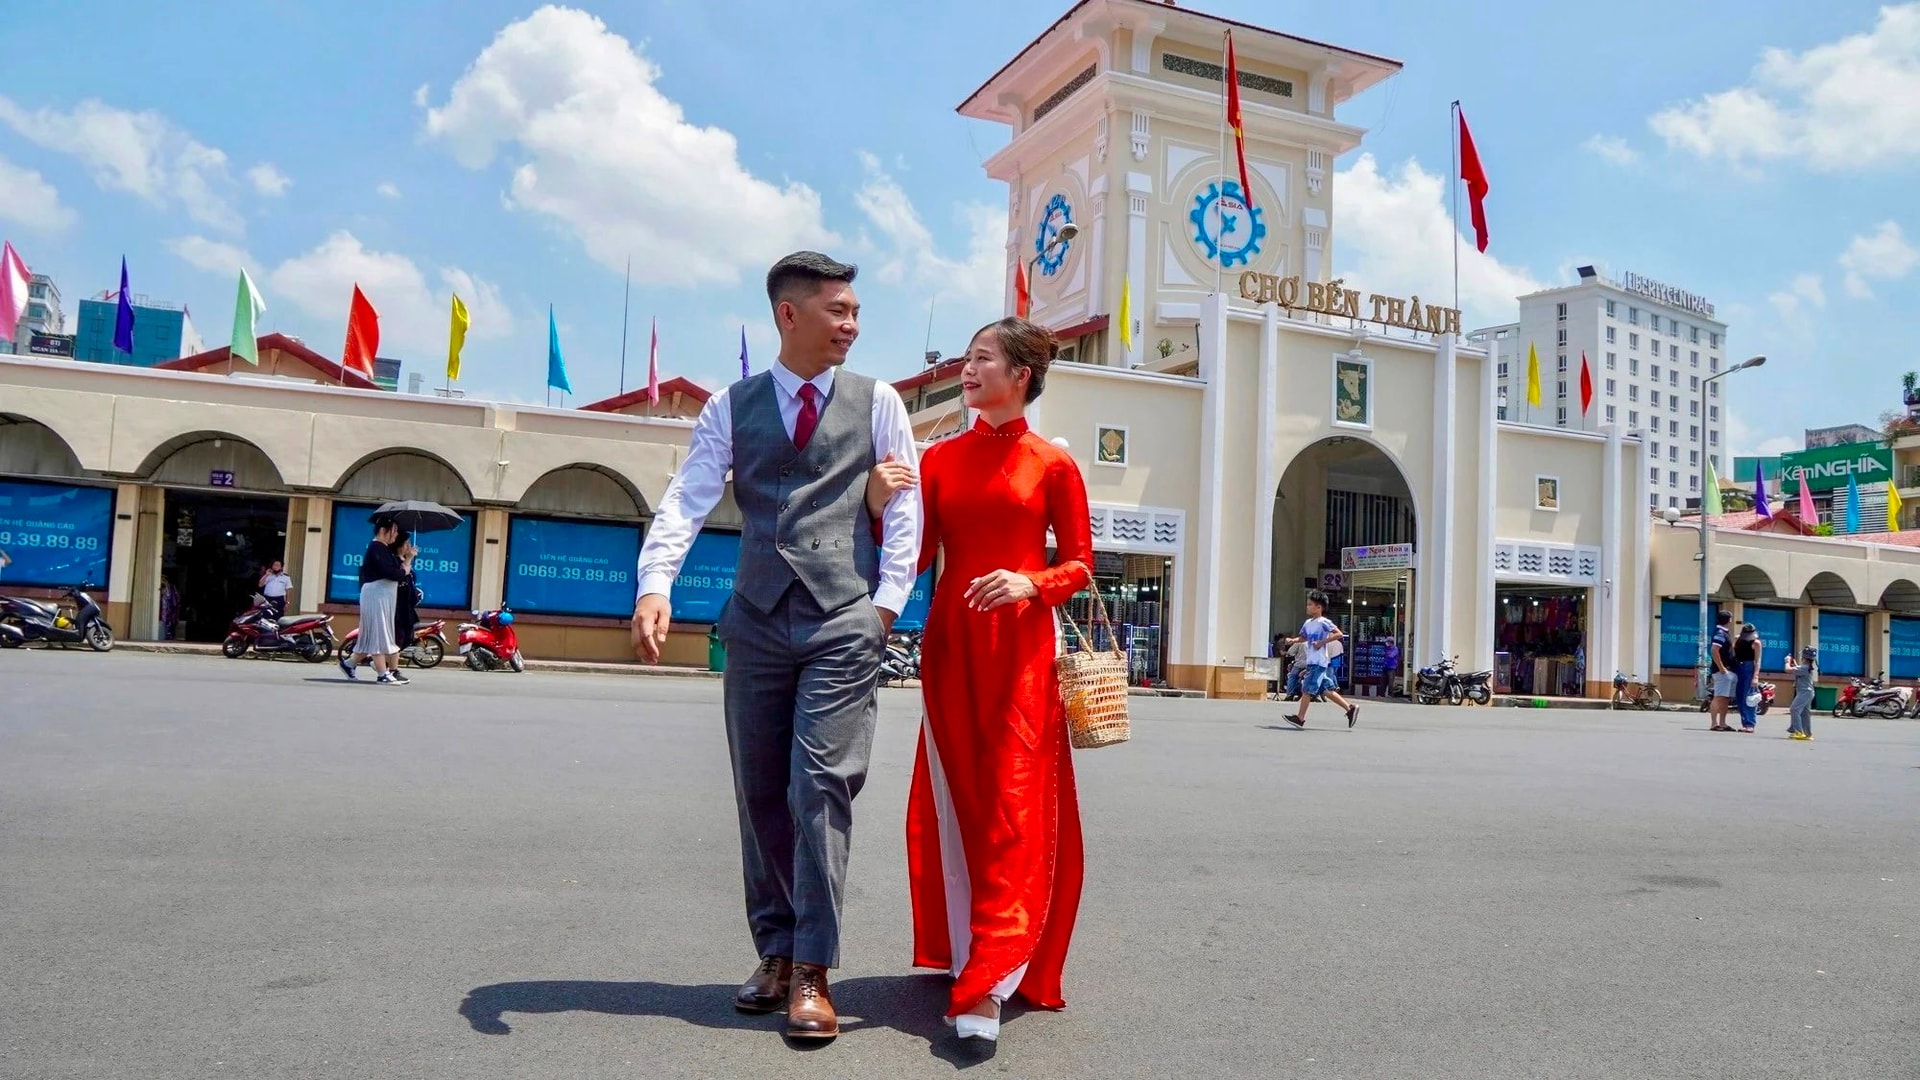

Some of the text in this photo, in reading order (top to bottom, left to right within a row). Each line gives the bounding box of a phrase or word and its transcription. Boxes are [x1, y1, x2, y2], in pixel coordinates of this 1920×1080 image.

[1239, 270, 1462, 336] CHỢ BẾN THÀNH
[224, 473, 233, 485] 2
[518, 563, 628, 583] 0969.39.89.89
